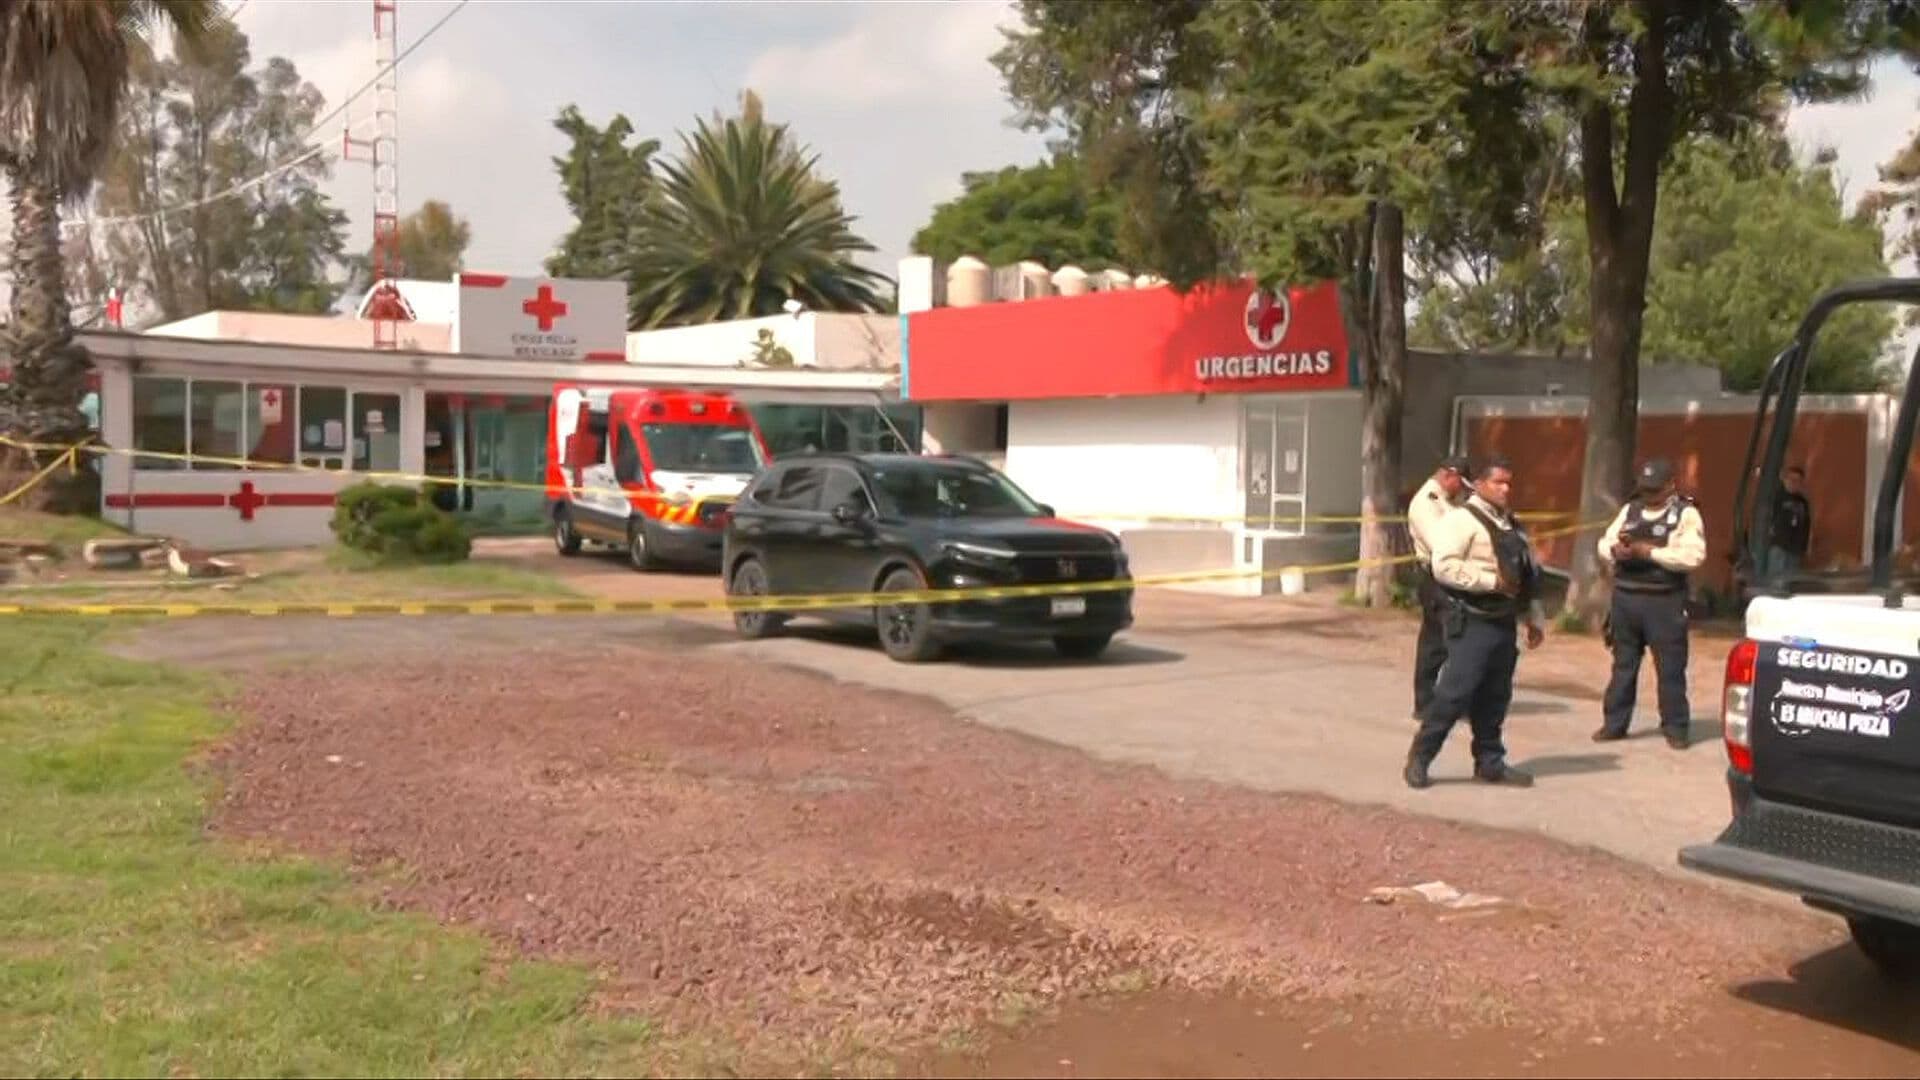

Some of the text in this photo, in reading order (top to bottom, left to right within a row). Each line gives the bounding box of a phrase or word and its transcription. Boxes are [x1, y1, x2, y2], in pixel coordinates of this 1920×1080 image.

[1195, 350, 1331, 379] URGENCIAS
[1777, 647, 1908, 679] SEGURIDAD
[1796, 704, 1847, 731] MUCHA
